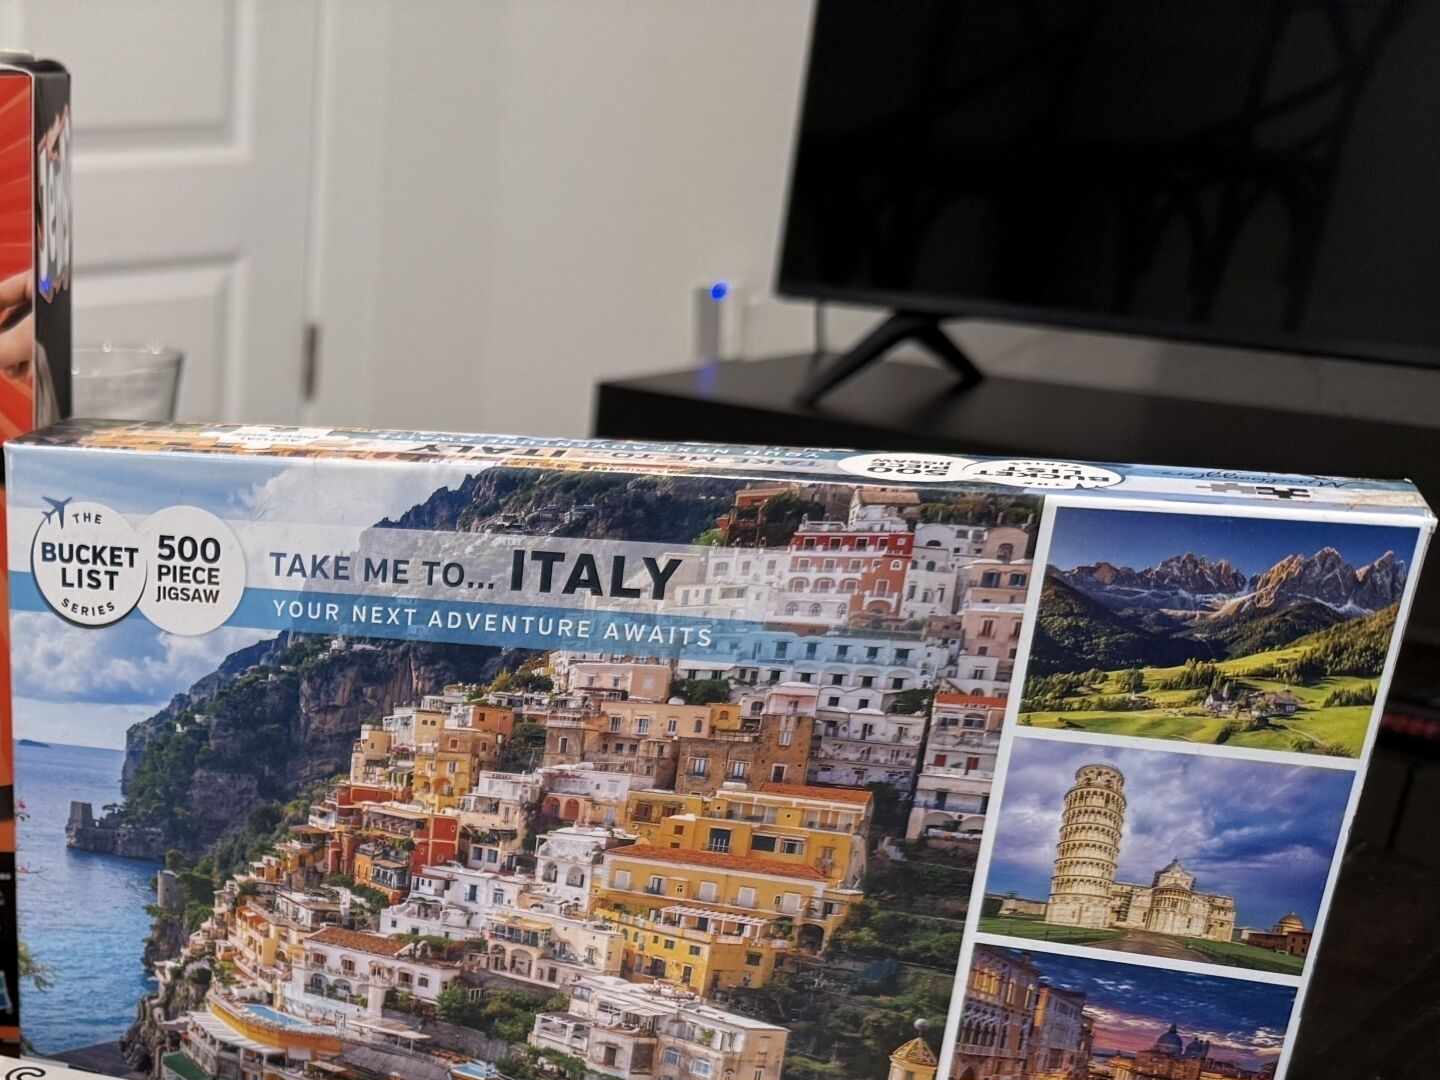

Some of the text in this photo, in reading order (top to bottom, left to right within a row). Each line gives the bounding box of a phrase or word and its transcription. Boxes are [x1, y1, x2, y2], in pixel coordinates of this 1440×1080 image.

[407, 444, 568, 458] ITALY
[866, 466, 947, 477] 500
[870, 462, 951, 471] PIECE
[1001, 466, 1082, 476] LIST
[973, 469, 1110, 483] BUCKET
[72, 512, 103, 525] THE
[41, 542, 139, 568] BUCKET
[157, 535, 221, 564] 500
[61, 567, 119, 591] LIST
[157, 565, 220, 586] PIECE
[270, 549, 683, 600] TAKE ME TO... ITALY
[156, 586, 220, 604] JIGSAW
[61, 598, 116, 616] SERIES
[273, 600, 712, 648] YOUR NEXT ADVENTURE AWAITS
